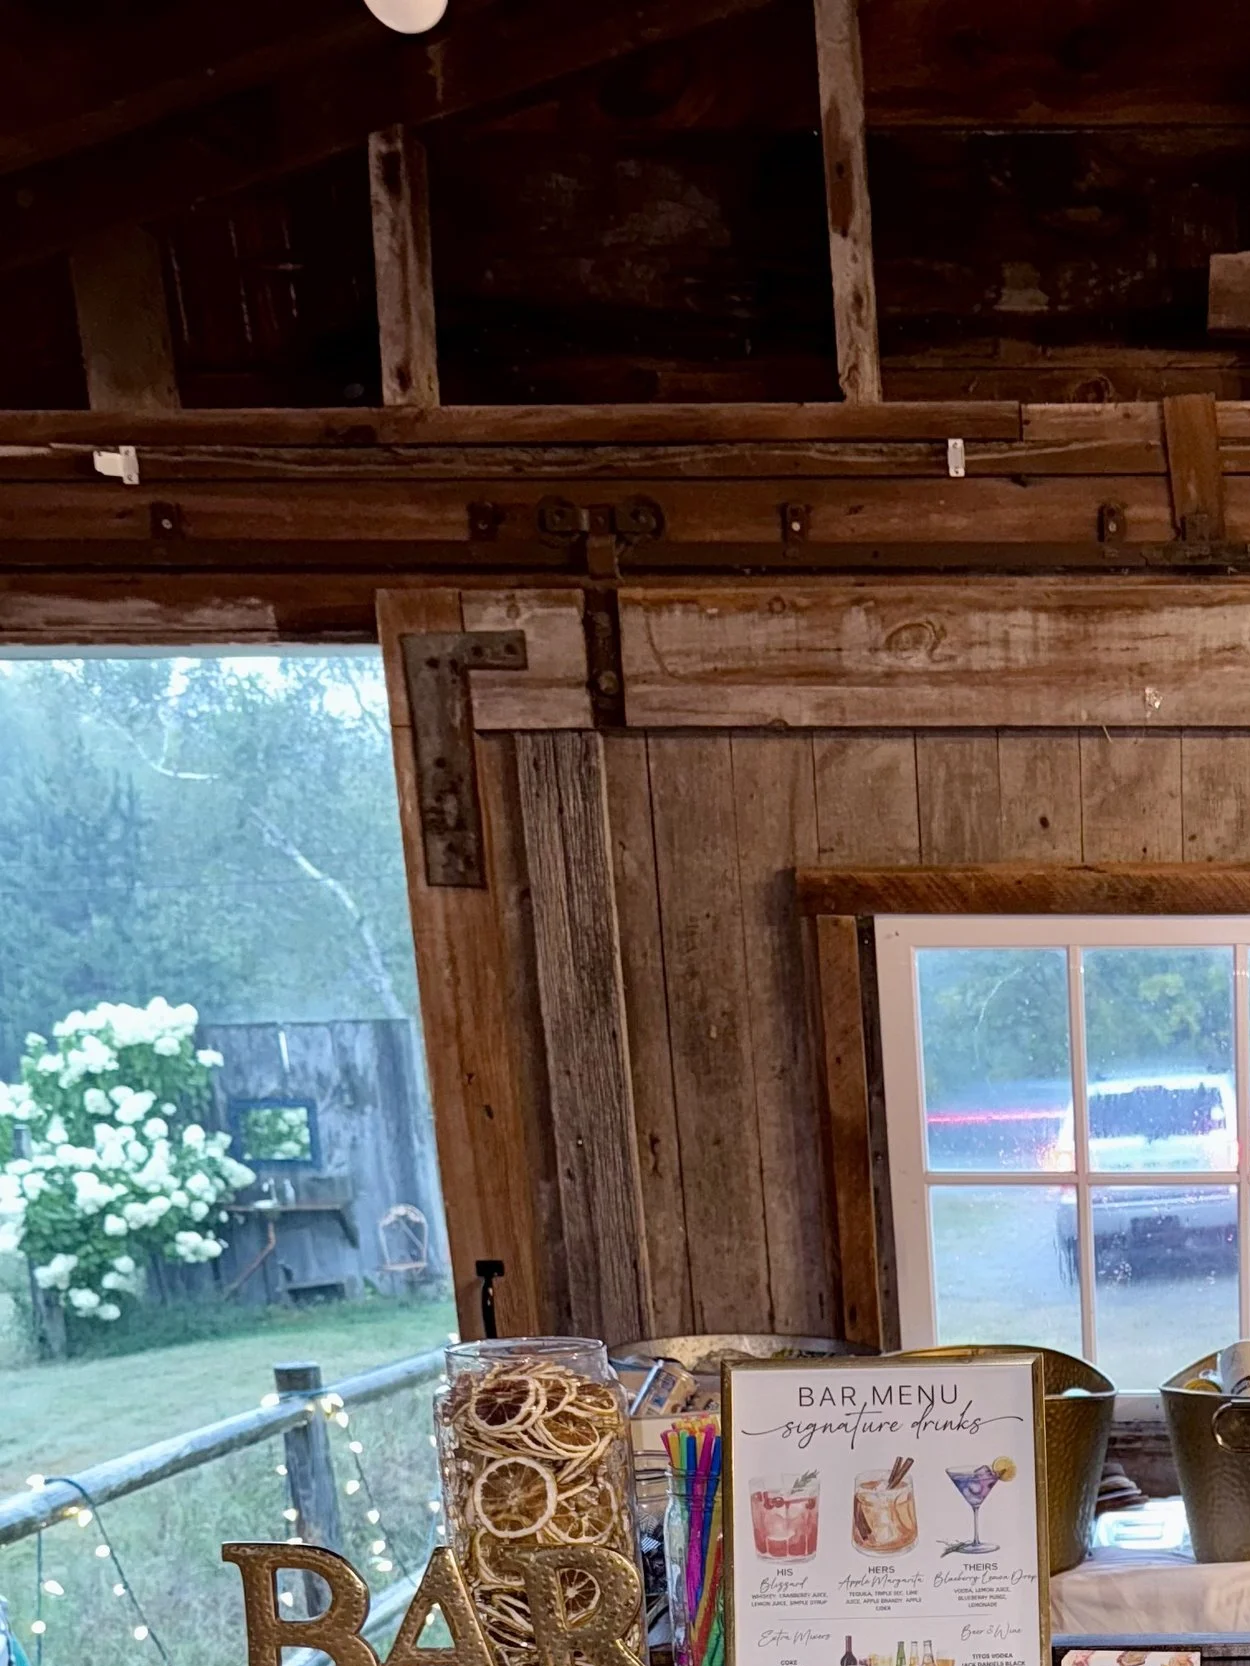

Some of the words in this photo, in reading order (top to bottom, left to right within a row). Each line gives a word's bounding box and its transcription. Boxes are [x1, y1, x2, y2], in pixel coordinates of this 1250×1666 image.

[798, 1386, 857, 1408] BAR
[871, 1384, 958, 1405] MENU
[741, 1401, 903, 1449] signature
[910, 1400, 1024, 1439] drinks
[868, 1566, 896, 1574] HERS
[963, 1563, 999, 1571] THEIRS
[776, 1568, 794, 1576] HIS
